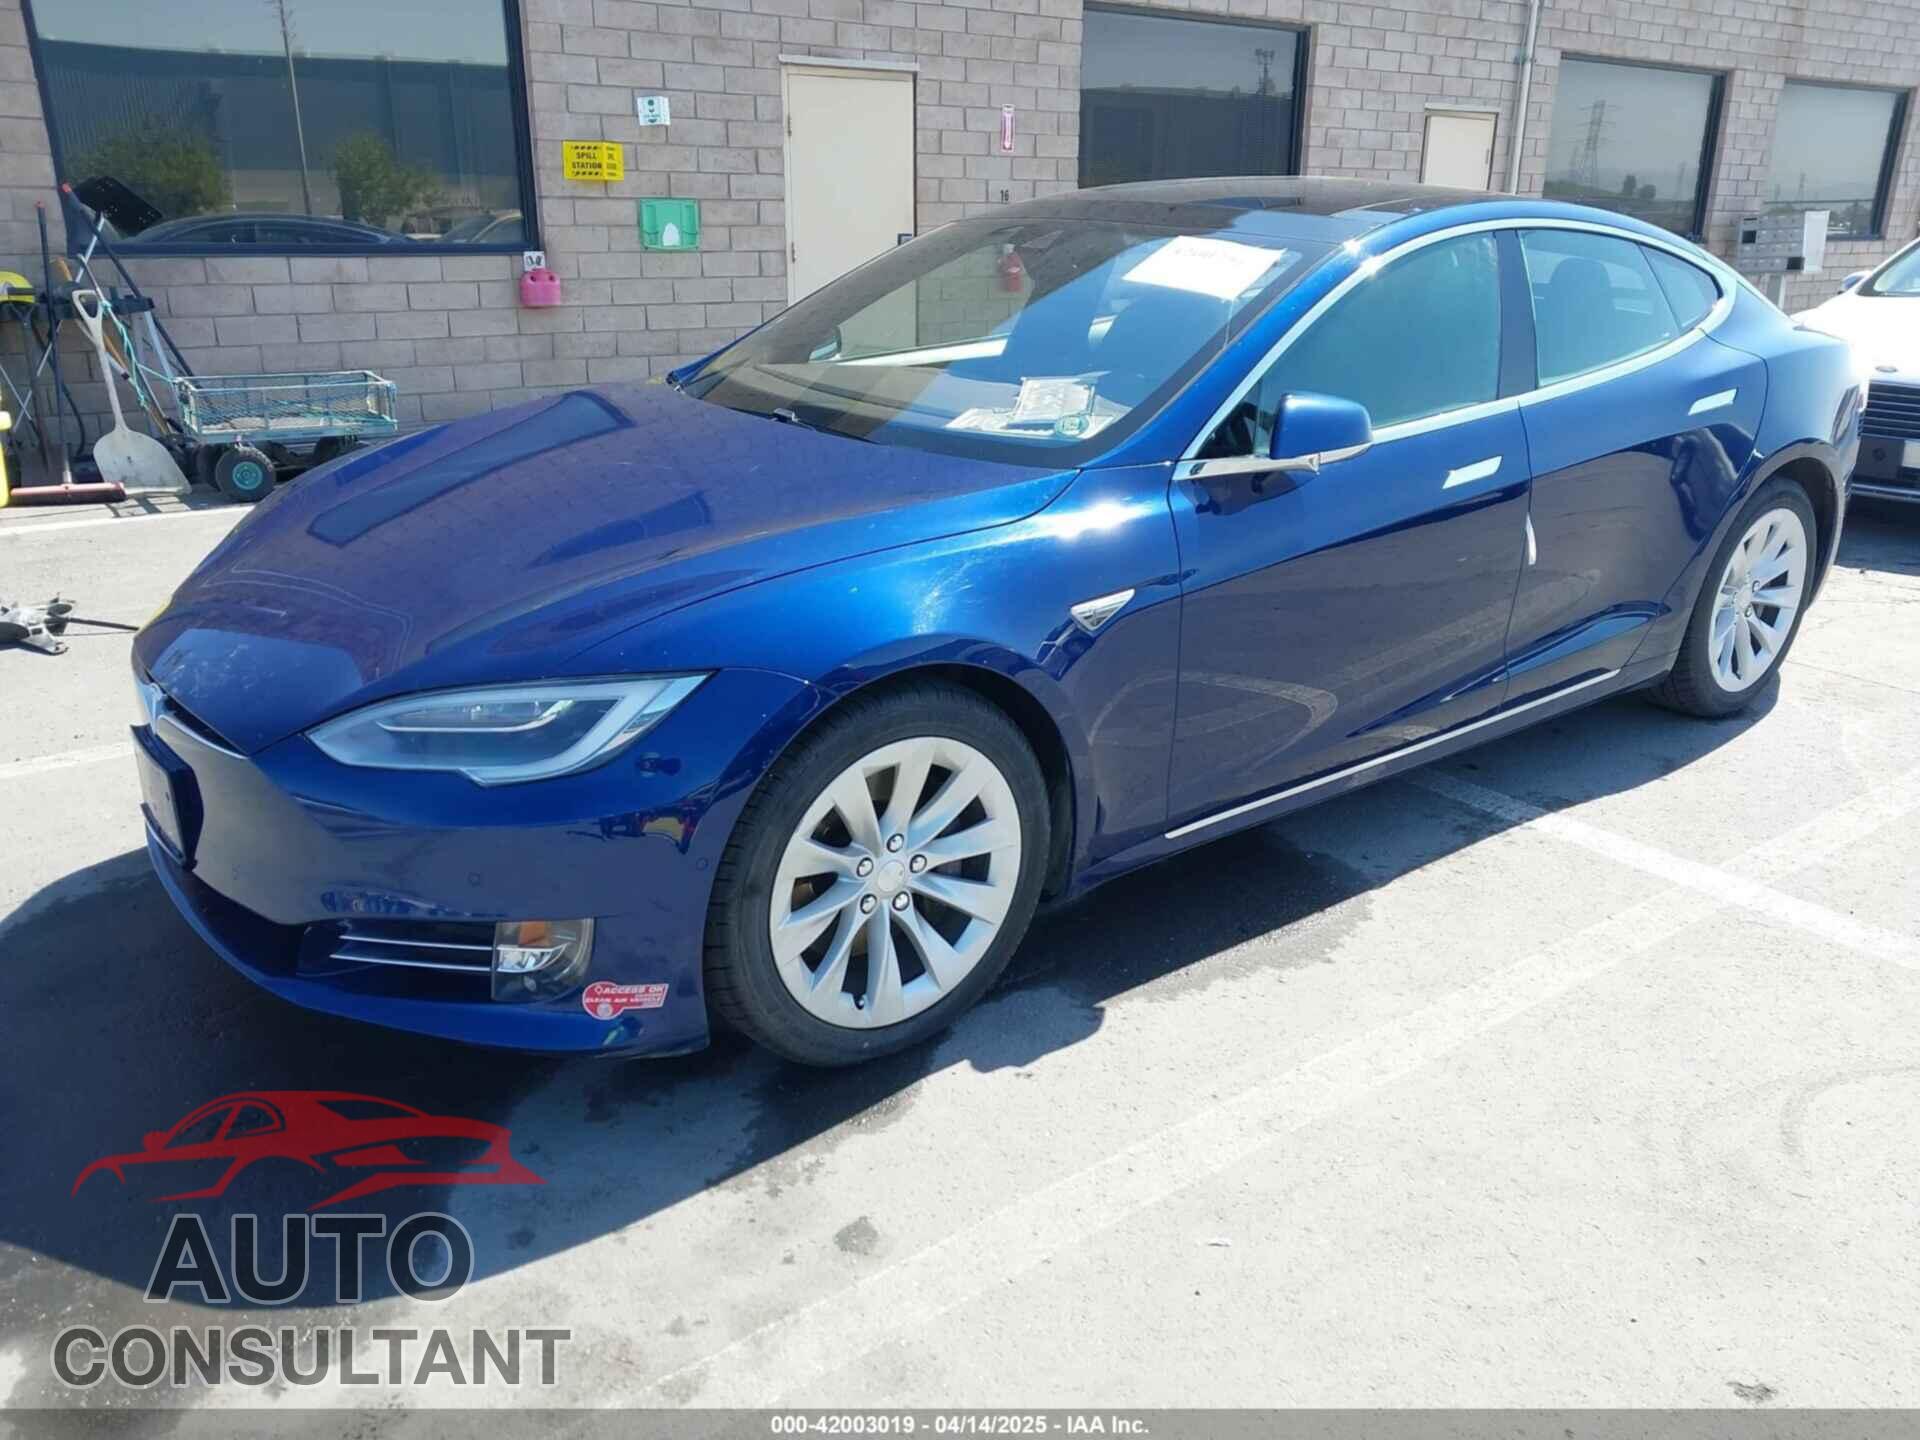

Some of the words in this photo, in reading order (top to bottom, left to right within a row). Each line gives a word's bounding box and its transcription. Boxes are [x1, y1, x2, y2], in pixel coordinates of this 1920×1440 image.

[576, 151, 597, 160] SPILL
[572, 161, 602, 169] STATION
[602, 985, 646, 994] ACCESS
